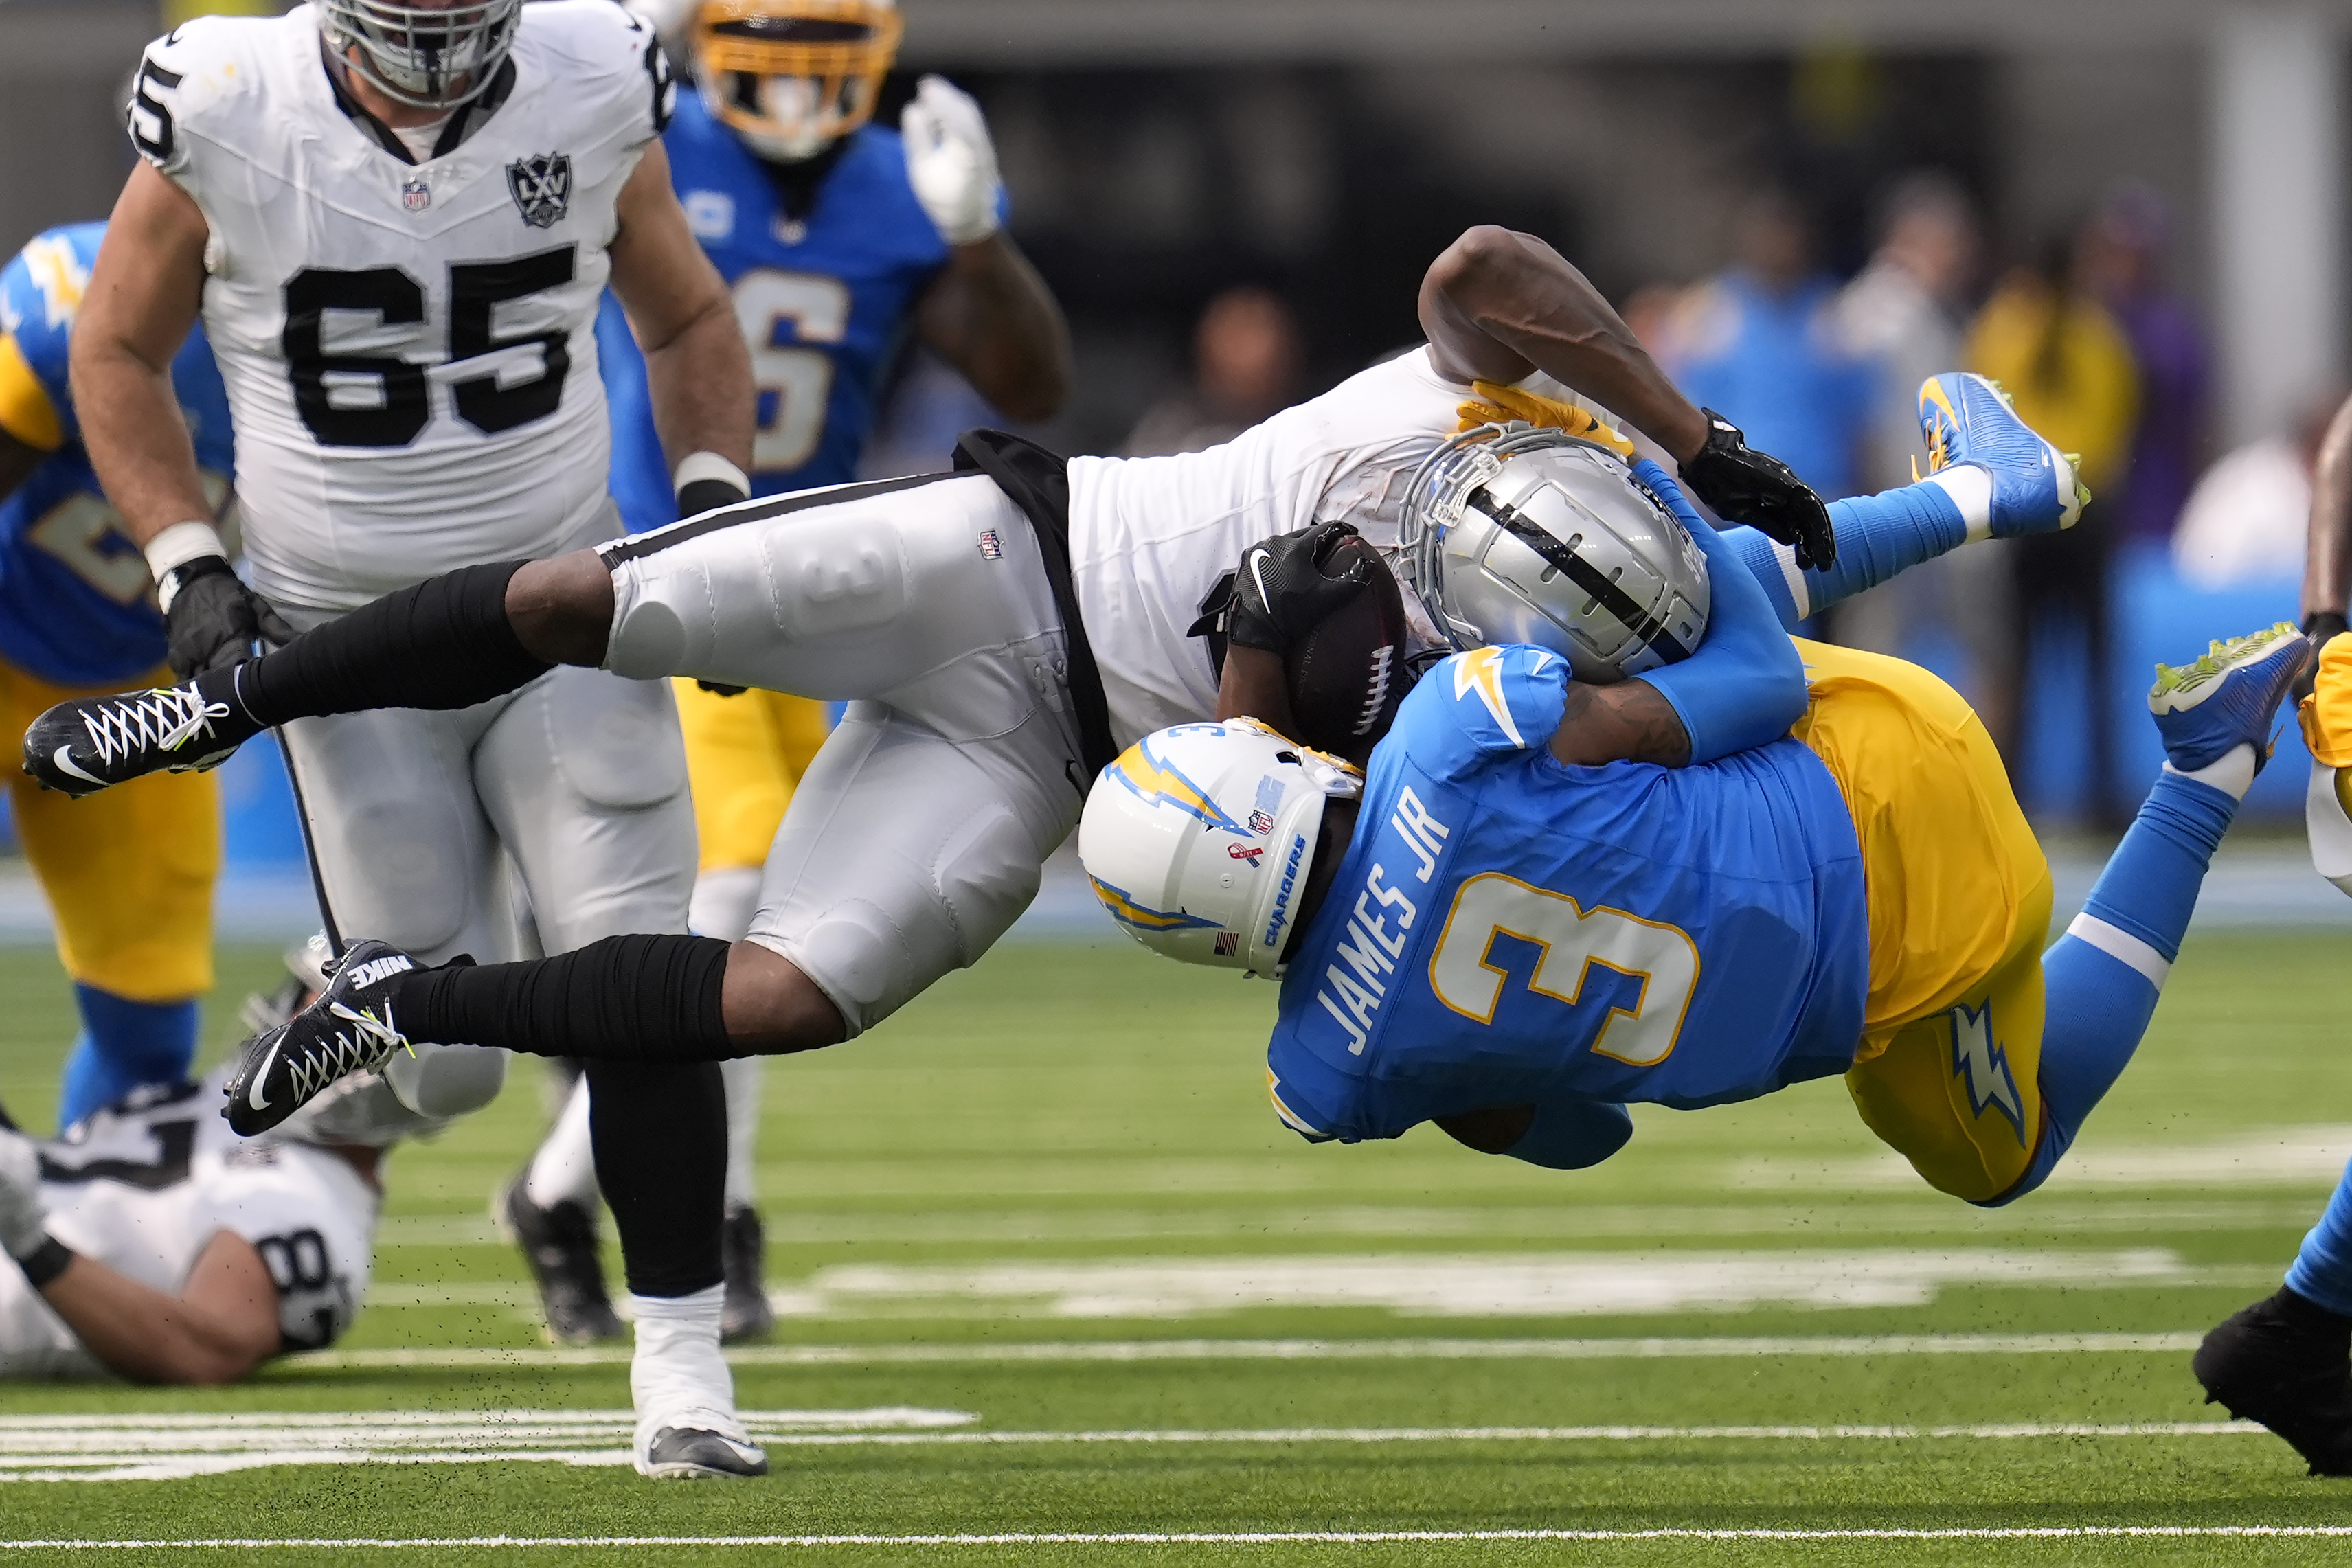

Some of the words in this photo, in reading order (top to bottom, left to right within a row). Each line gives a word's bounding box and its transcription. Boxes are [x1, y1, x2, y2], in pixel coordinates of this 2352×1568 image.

[282, 240, 578, 448] 65
[730, 268, 852, 473] 6
[982, 533, 994, 554] NFL
[1256, 816, 1271, 833] NFL
[1264, 833, 1306, 947] CHARGERS
[346, 955, 414, 990] NIKE
[1316, 863, 1416, 1056] JAMES
[1390, 784, 1450, 883] JR
[1429, 872, 1701, 1067] 3
